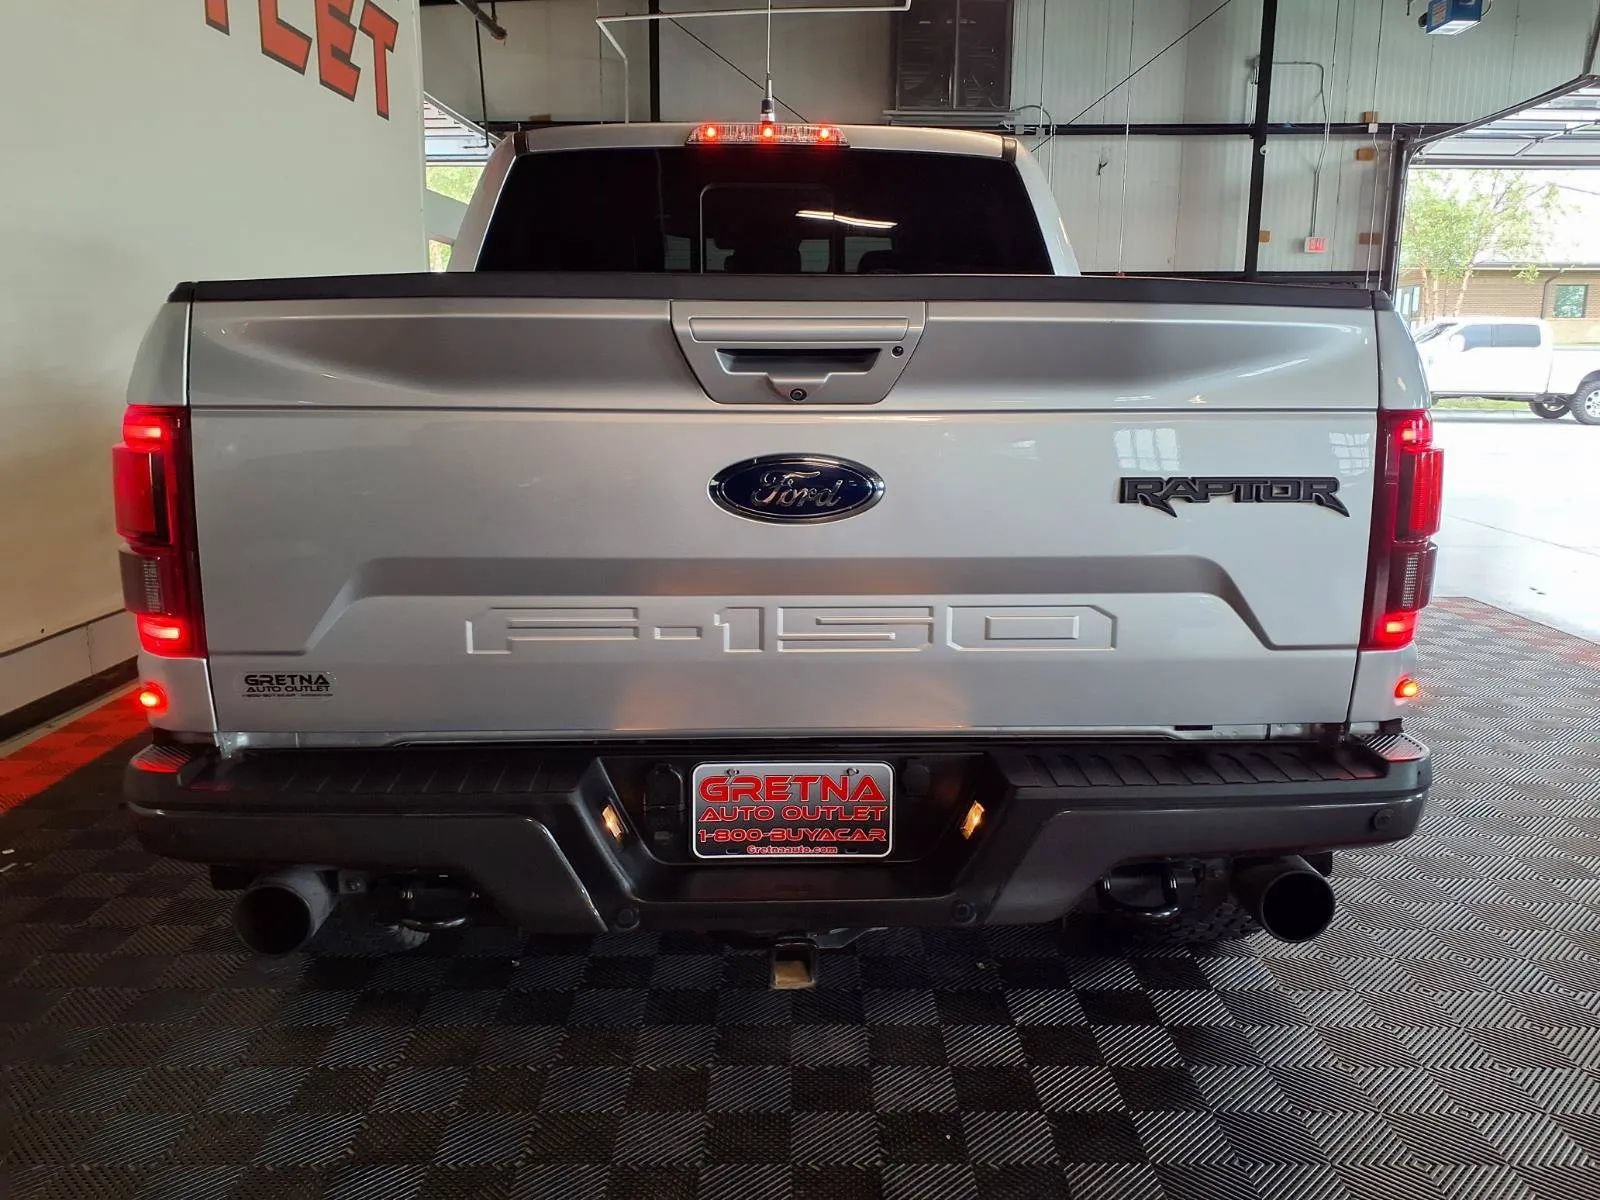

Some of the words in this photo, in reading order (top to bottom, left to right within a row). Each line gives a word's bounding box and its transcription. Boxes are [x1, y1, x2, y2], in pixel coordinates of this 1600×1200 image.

[204, 0, 399, 120] LET
[751, 470, 843, 508] Ford
[1119, 476, 1350, 518] RAPTOR
[465, 605, 1117, 654] F-150
[244, 674, 330, 686] GRETNA
[699, 775, 887, 803] GRETNA
[699, 806, 774, 821] AUTO
[781, 806, 887, 821] OUTLET
[698, 828, 887, 842] 1-800-BUYACAR
[746, 845, 838, 854] Gretnaauto.com
